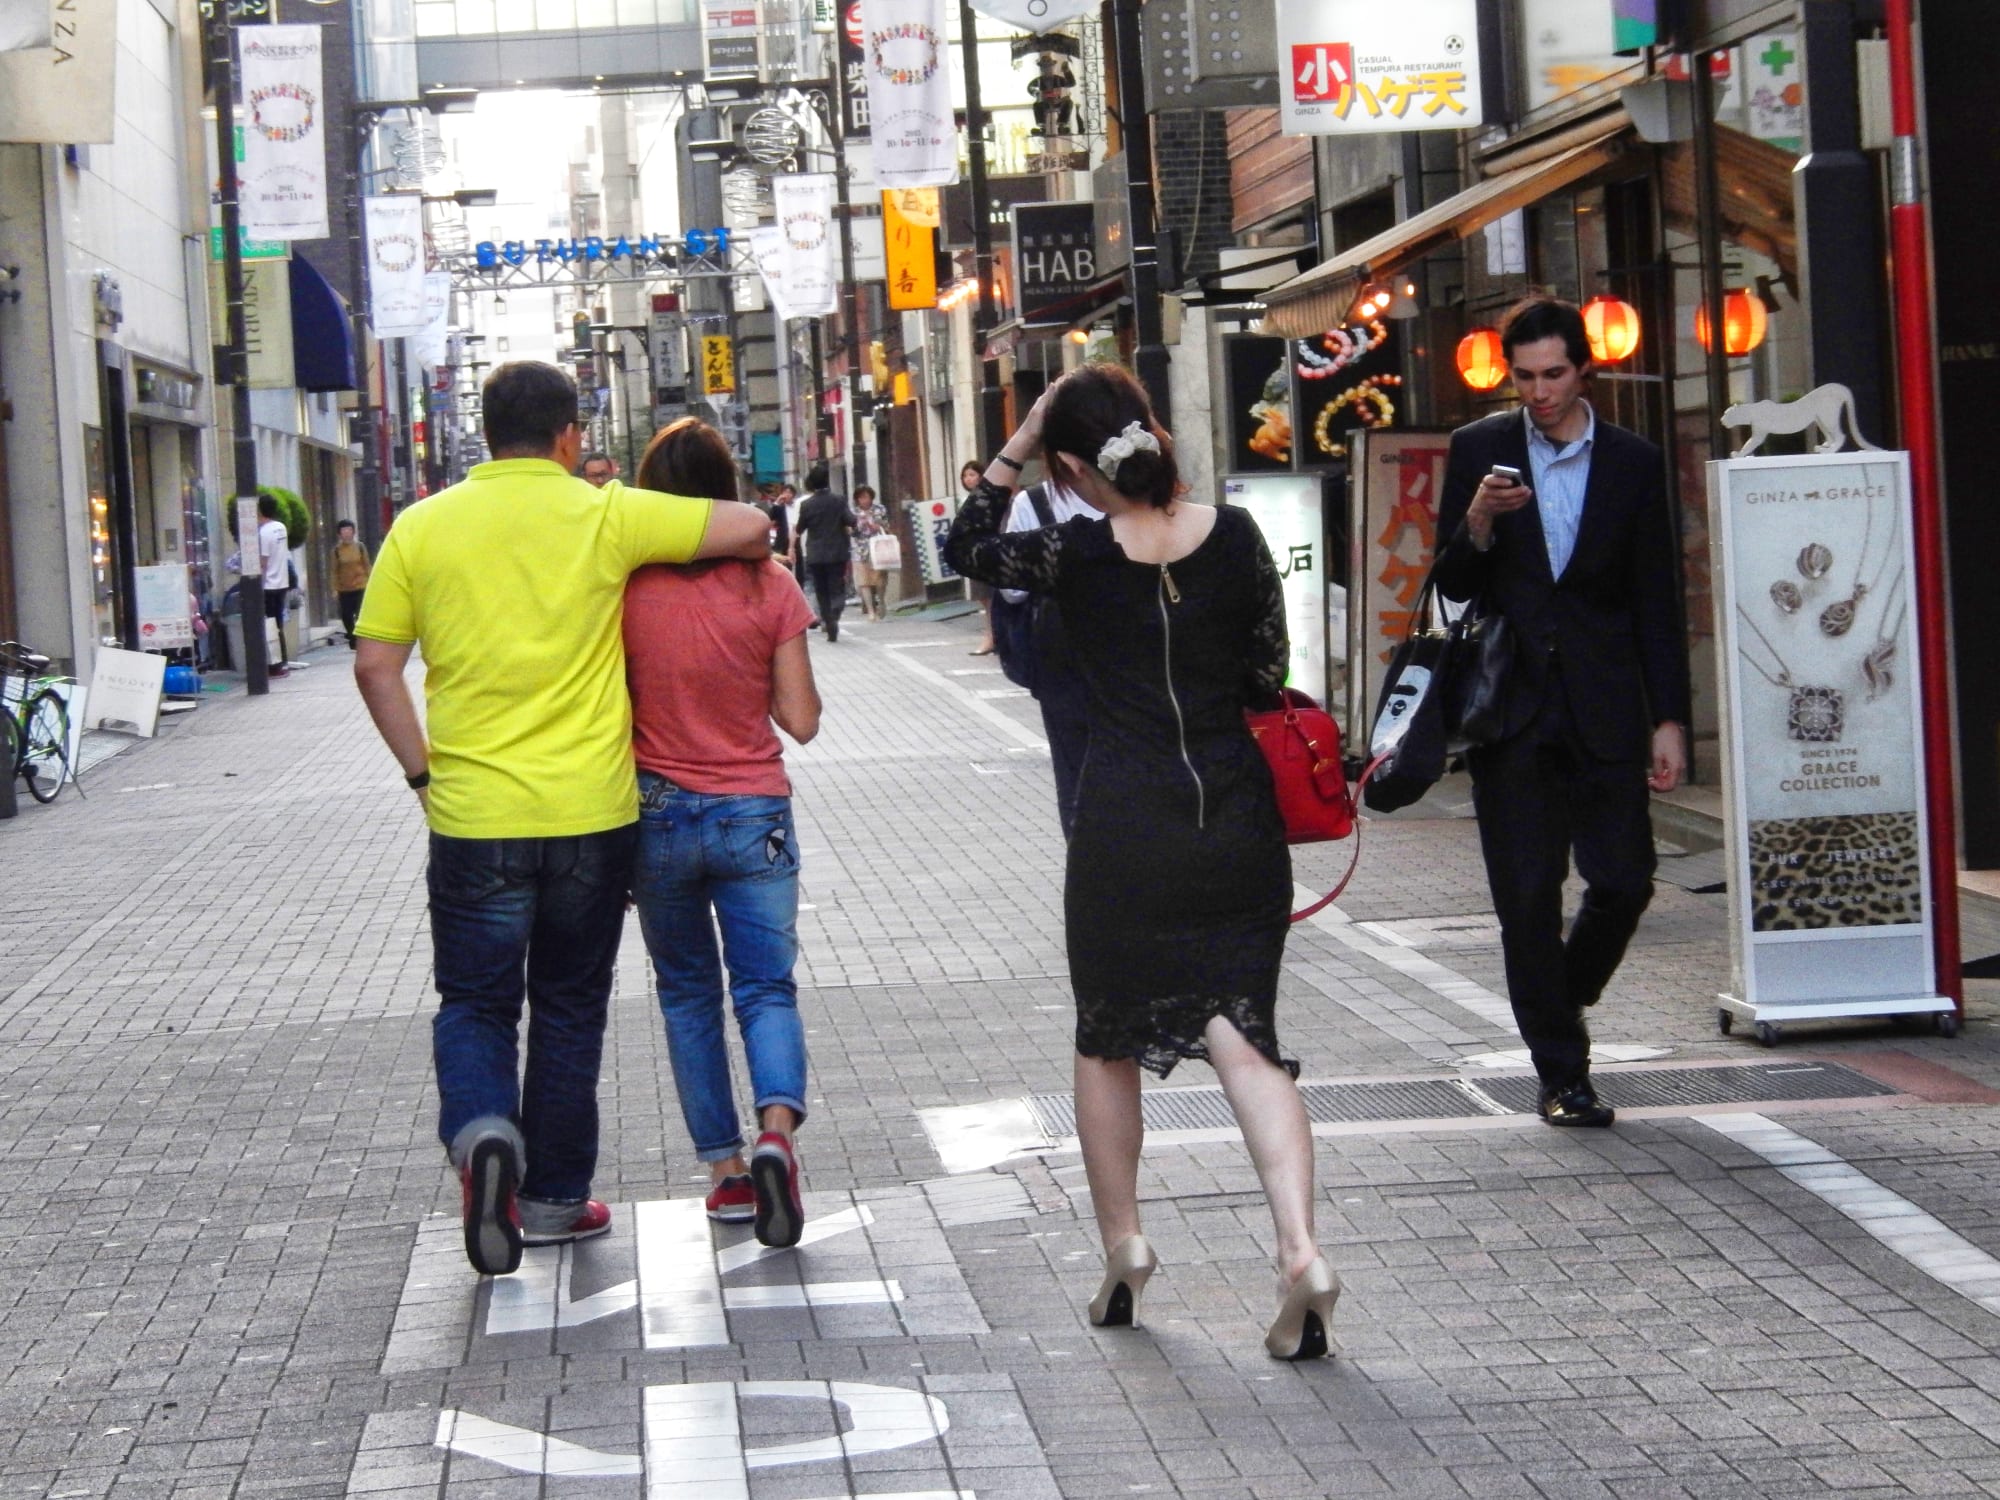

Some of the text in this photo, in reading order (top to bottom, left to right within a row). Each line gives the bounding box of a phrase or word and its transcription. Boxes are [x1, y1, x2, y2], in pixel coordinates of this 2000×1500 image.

[1357, 56, 1393, 64] CASUAL
[1359, 61, 1463, 74] TEMPURA RESTAURANT
[1297, 47, 1348, 95] 小
[1332, 71, 1467, 120] ハゲ天
[1295, 107, 1321, 116] GINZA
[475, 227, 732, 268] SUZURAN ST
[1023, 248, 1096, 284] HAB
[1746, 485, 1887, 504] GINZA GRACE
[1801, 749, 1831, 759] SINCE
[1801, 760, 1857, 776] GRACE
[1780, 775, 1881, 792] COLLECTION
[1768, 853, 1798, 865] FUR
